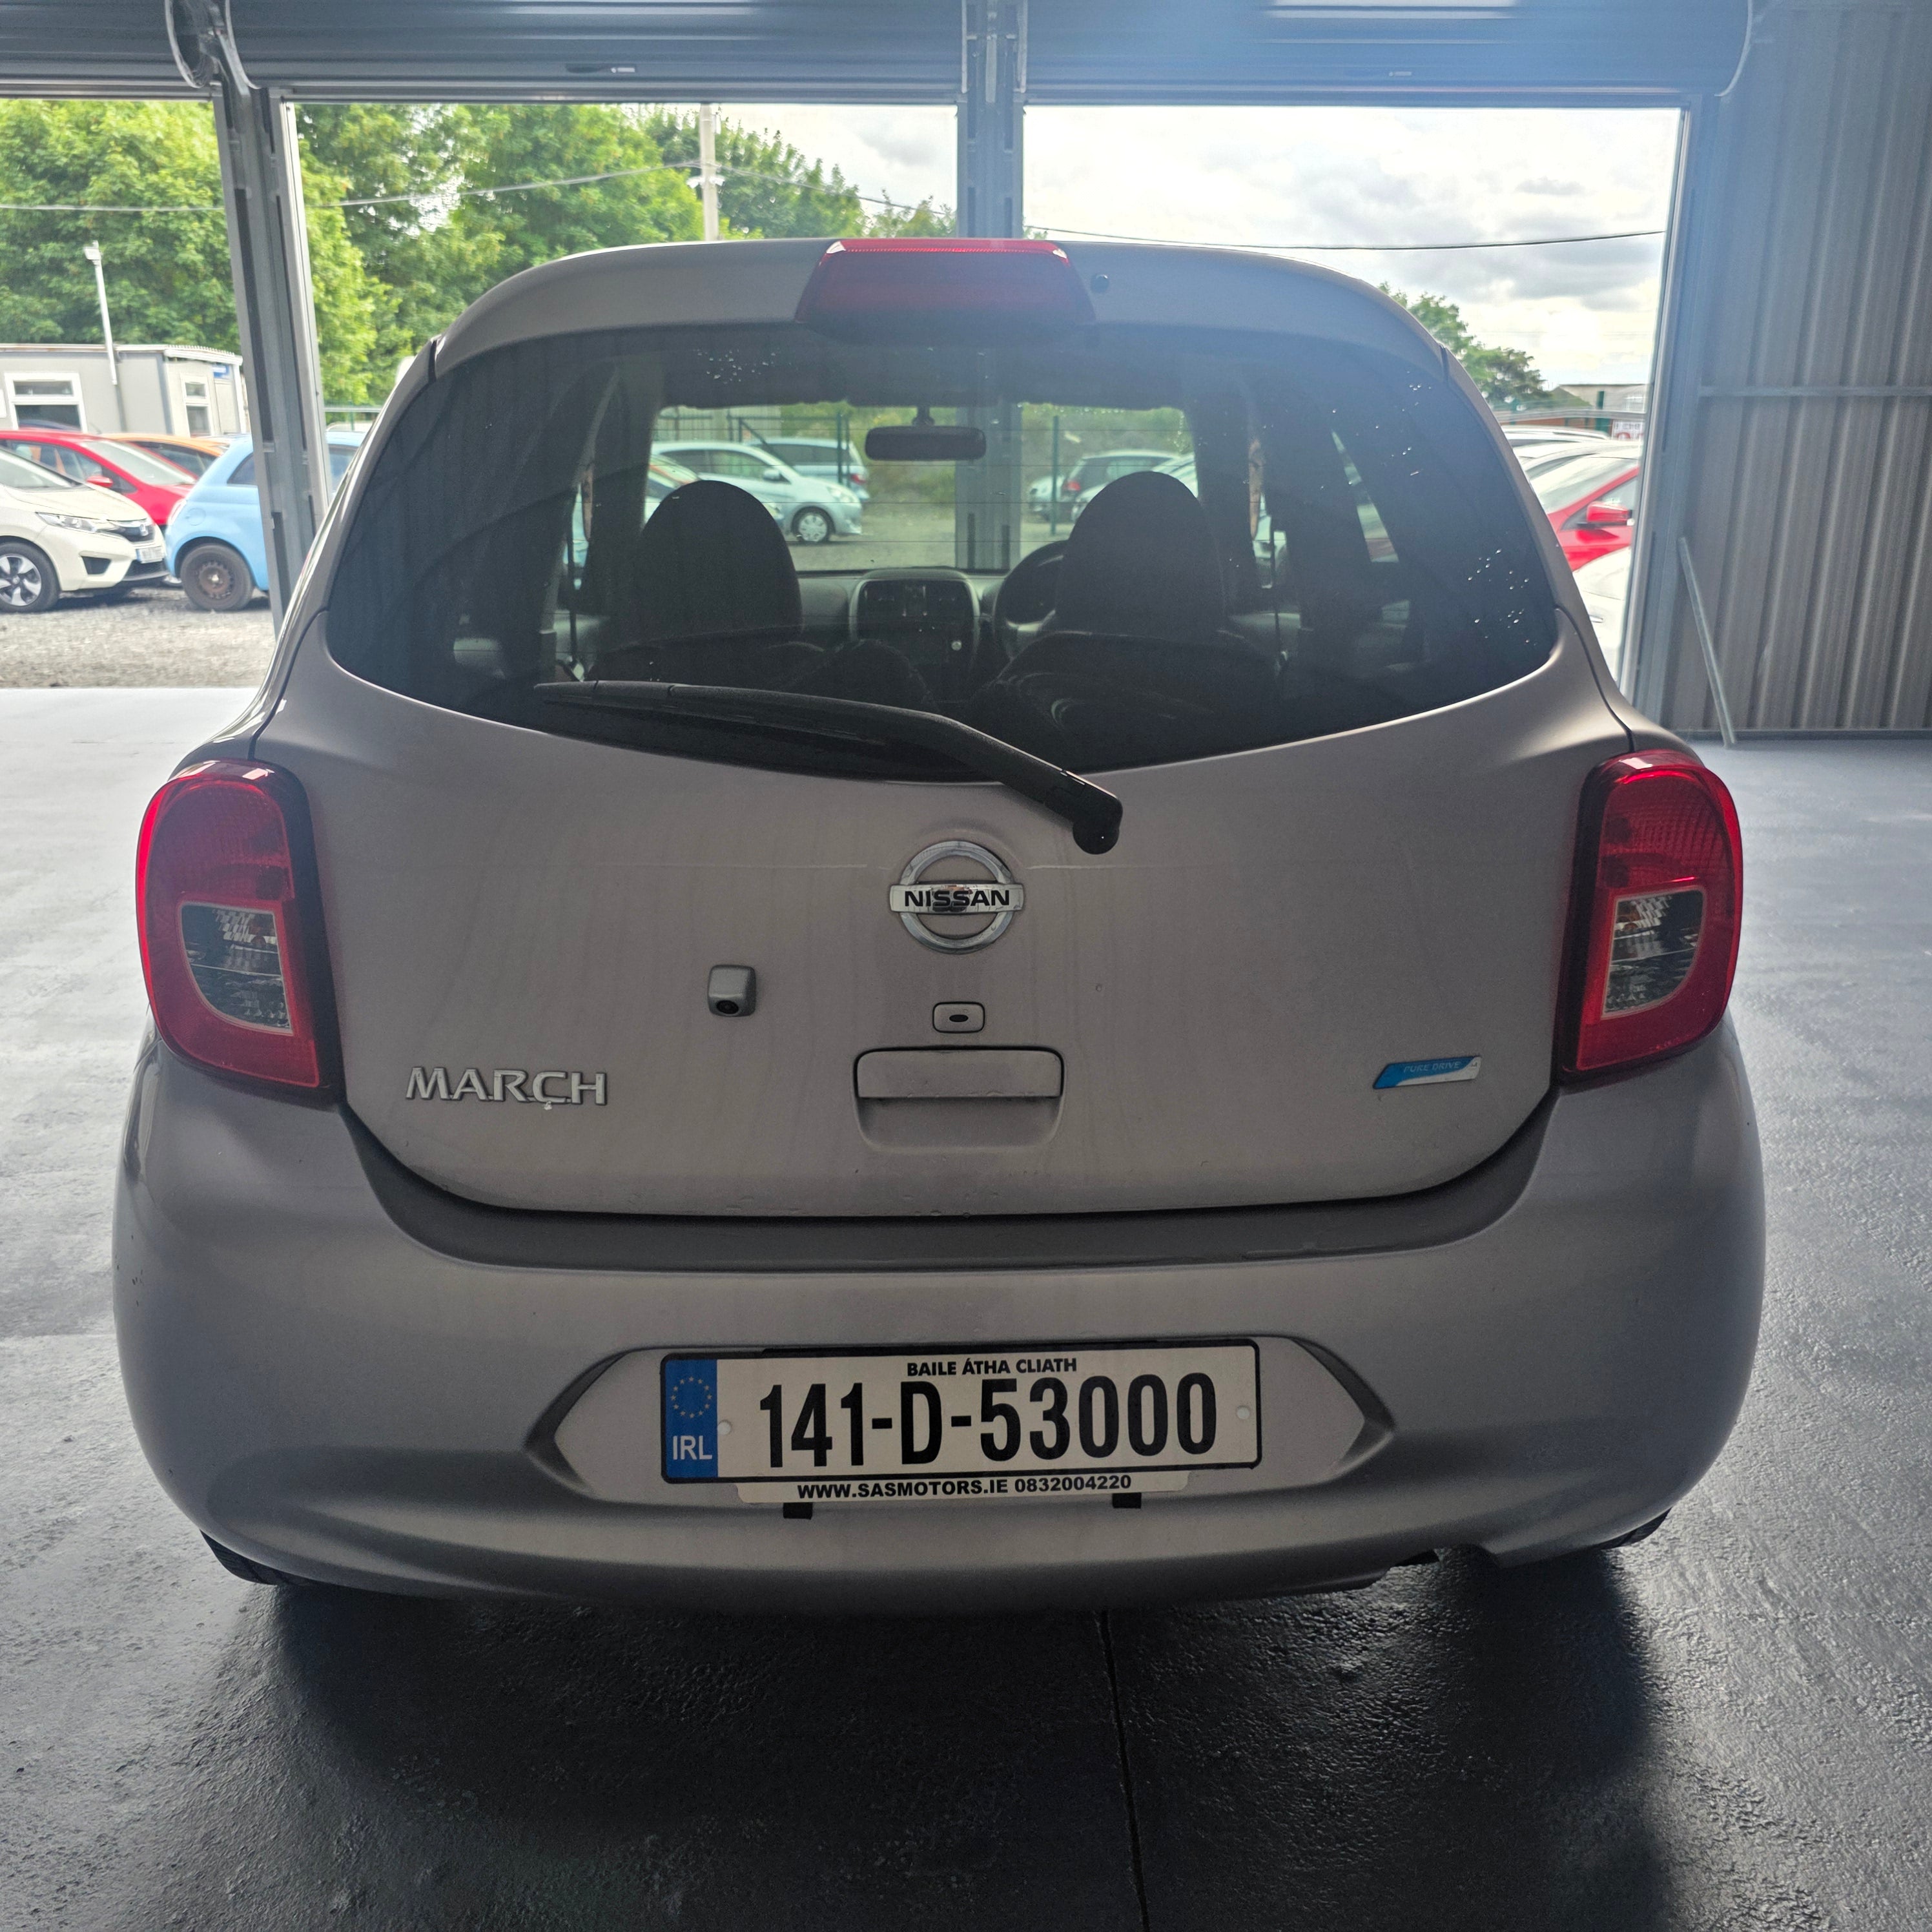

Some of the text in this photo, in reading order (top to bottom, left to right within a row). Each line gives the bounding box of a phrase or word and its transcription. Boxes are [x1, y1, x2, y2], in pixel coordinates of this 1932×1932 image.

[905, 890, 1010, 907] NISSAN
[1404, 1061, 1462, 1073] PURE DRIVE
[406, 1067, 606, 1105] MARCH
[907, 1358, 1077, 1376] BAILE ÁTHA CLIATH
[759, 1372, 1217, 1468] 141-D-53000
[672, 1435, 713, 1460] IRL
[797, 1475, 1131, 1499] WWW.SASMOTORS.IE 0832004220
